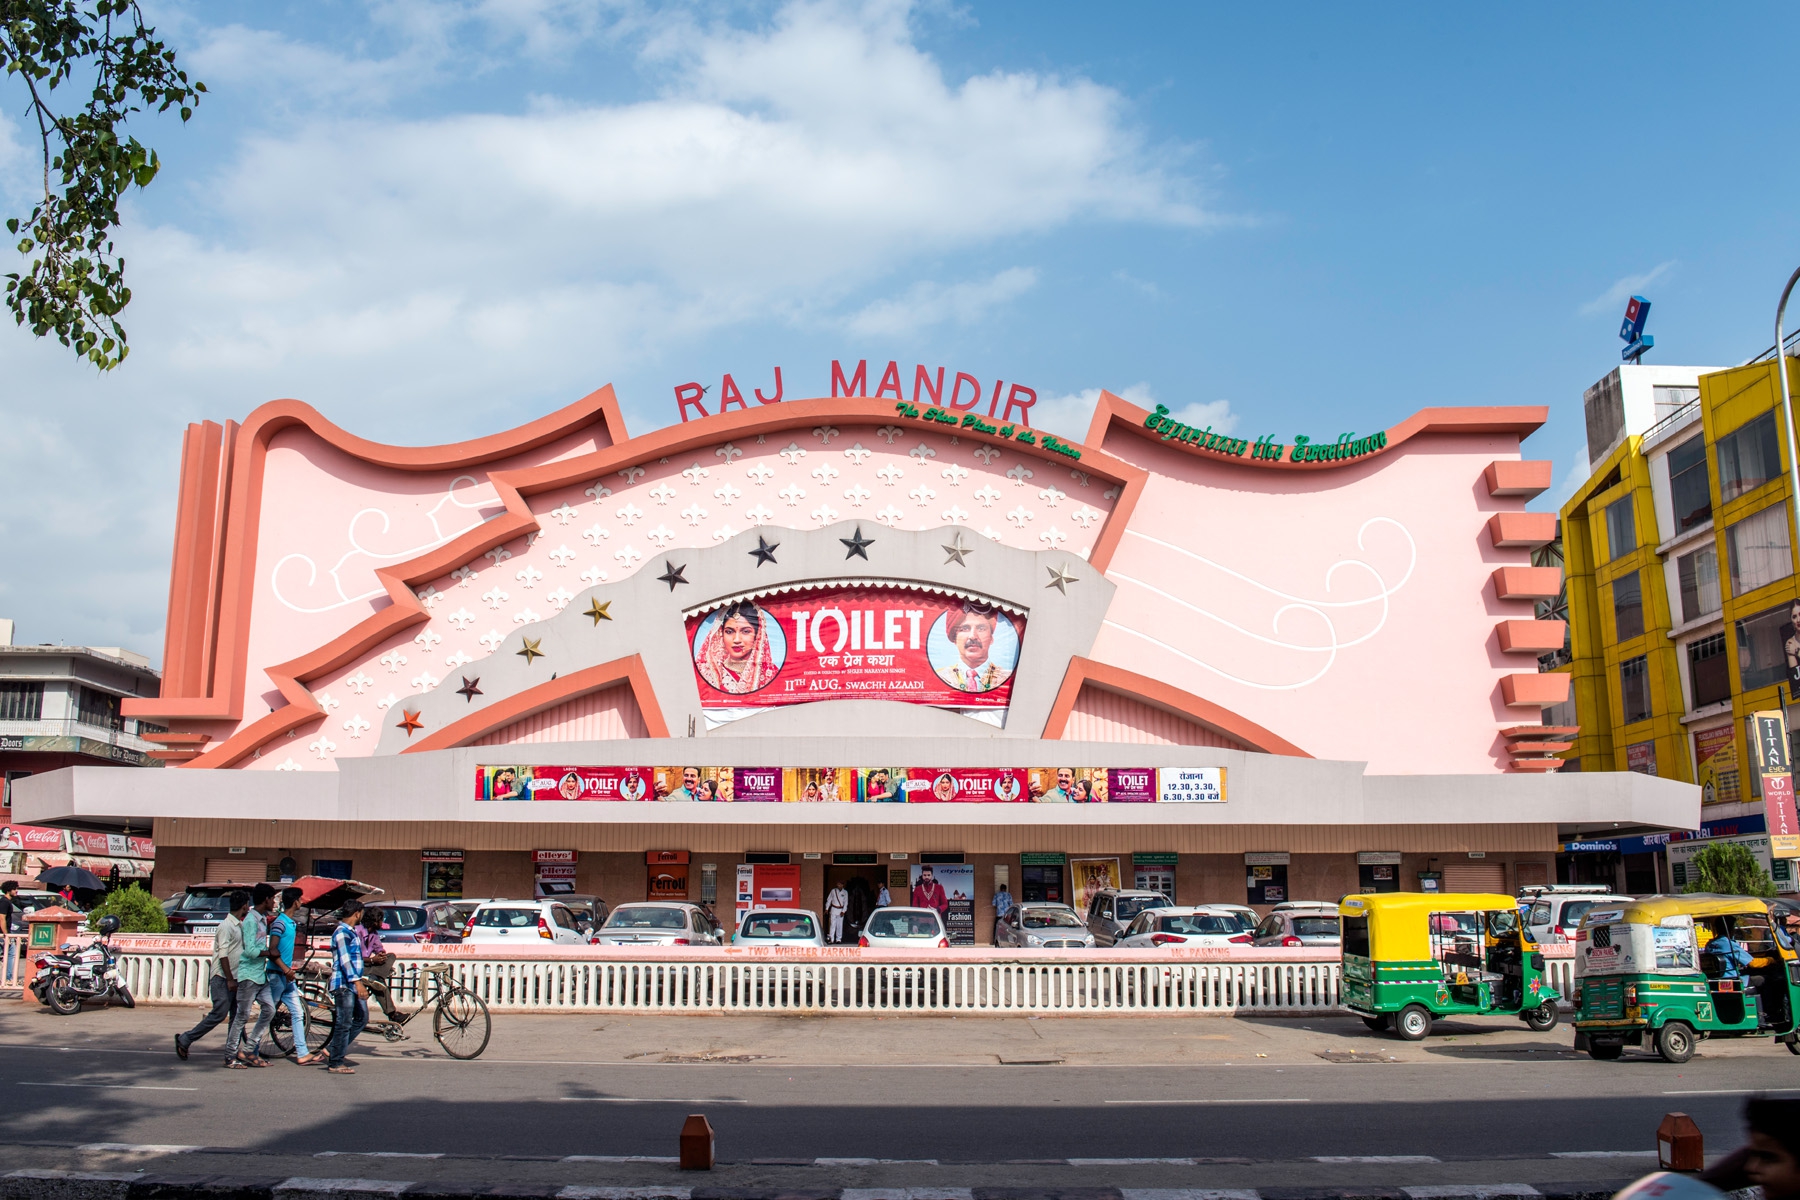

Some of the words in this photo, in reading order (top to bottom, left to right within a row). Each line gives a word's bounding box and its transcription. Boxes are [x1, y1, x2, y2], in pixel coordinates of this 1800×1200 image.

[674, 366, 783, 423] RAJ
[831, 359, 1037, 426] MANDIR
[896, 403, 919, 417] The
[923, 407, 958, 424] Show
[962, 414, 997, 434] Place
[1000, 424, 1015, 437] of
[1016, 430, 1036, 444] the
[1145, 404, 1248, 456] Experience
[1252, 434, 1284, 460] the
[1291, 431, 1388, 461] Excellence
[791, 606, 923, 653] TOILET
[818, 655, 840, 668] एक
[843, 652, 863, 667] प्रेम
[867, 654, 895, 667] कथा
[809, 678, 842, 691] AUG.
[845, 681, 887, 690] SWACHH
[888, 680, 924, 690] AZAADI
[1, 737, 23, 748] Doors
[1764, 719, 1780, 765] TITAN
[584, 777, 618, 790] TOILET
[743, 775, 775, 787] TOILET
[958, 778, 993, 791] TOILET
[1118, 775, 1149, 787] TOILET
[1168, 783, 1193, 791] 12.30,
[1194, 783, 1216, 791] 3.30,
[1163, 793, 1184, 801] 6.30,
[1186, 793, 1205, 801] 9.30
[1777, 802, 1788, 835] TITAN
[1572, 841, 1618, 851] Domino's
[948, 912, 971, 920] Fashion
[39, 931, 49, 939] IN
[112, 939, 132, 947] TWO
[135, 939, 172, 948] WHEELER
[176, 940, 212, 949] PARKING
[422, 944, 435, 953] NO
[438, 944, 476, 954] PARKING
[1539, 944, 1573, 953] ARKING
[748, 946, 769, 956] TWO
[775, 947, 818, 957] WHEELER
[821, 947, 861, 957] PARKING
[1171, 948, 1186, 957] NO
[1189, 947, 1231, 958] PARKING
